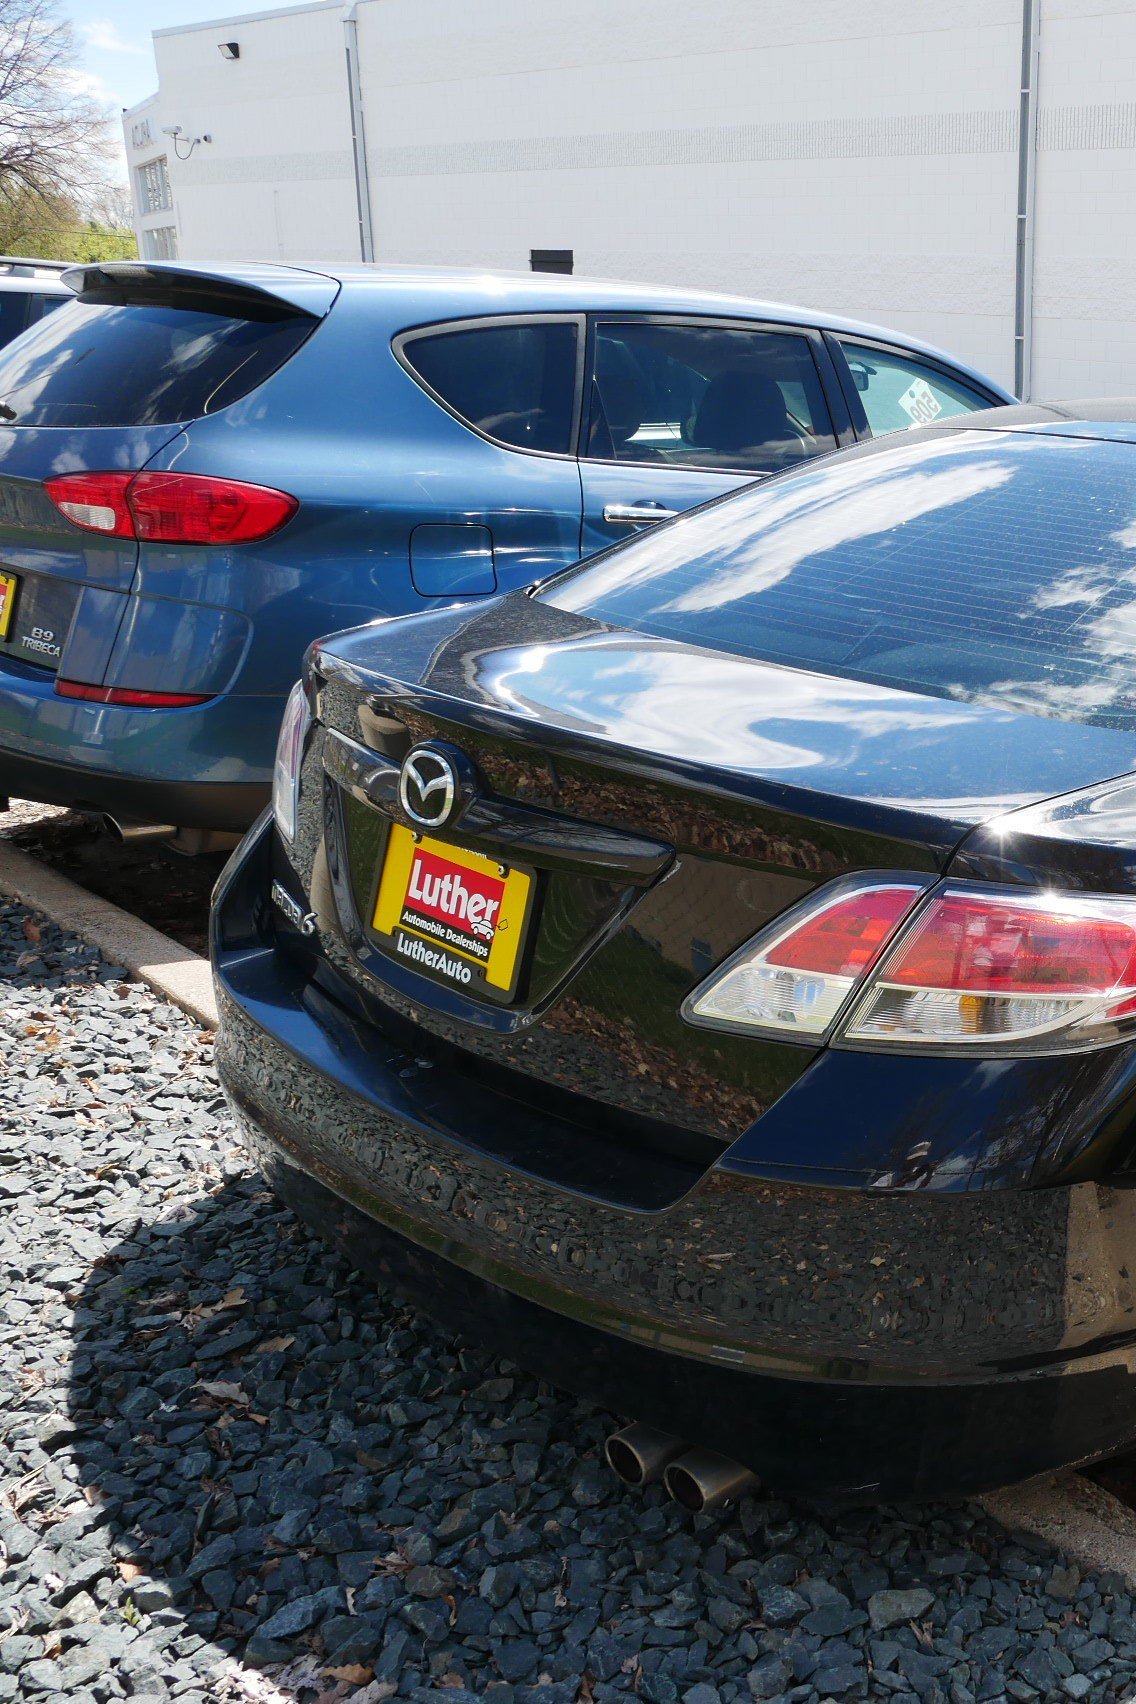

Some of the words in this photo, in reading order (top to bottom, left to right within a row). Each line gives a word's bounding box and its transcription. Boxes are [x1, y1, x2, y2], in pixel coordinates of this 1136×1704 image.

[21, 636, 61, 657] TRIBECA
[31, 627, 54, 642] B9
[408, 859, 500, 923] Luther
[402, 910, 445, 938] Automobile
[446, 928, 488, 957] Dealerships
[397, 933, 472, 984] LutherAuto
